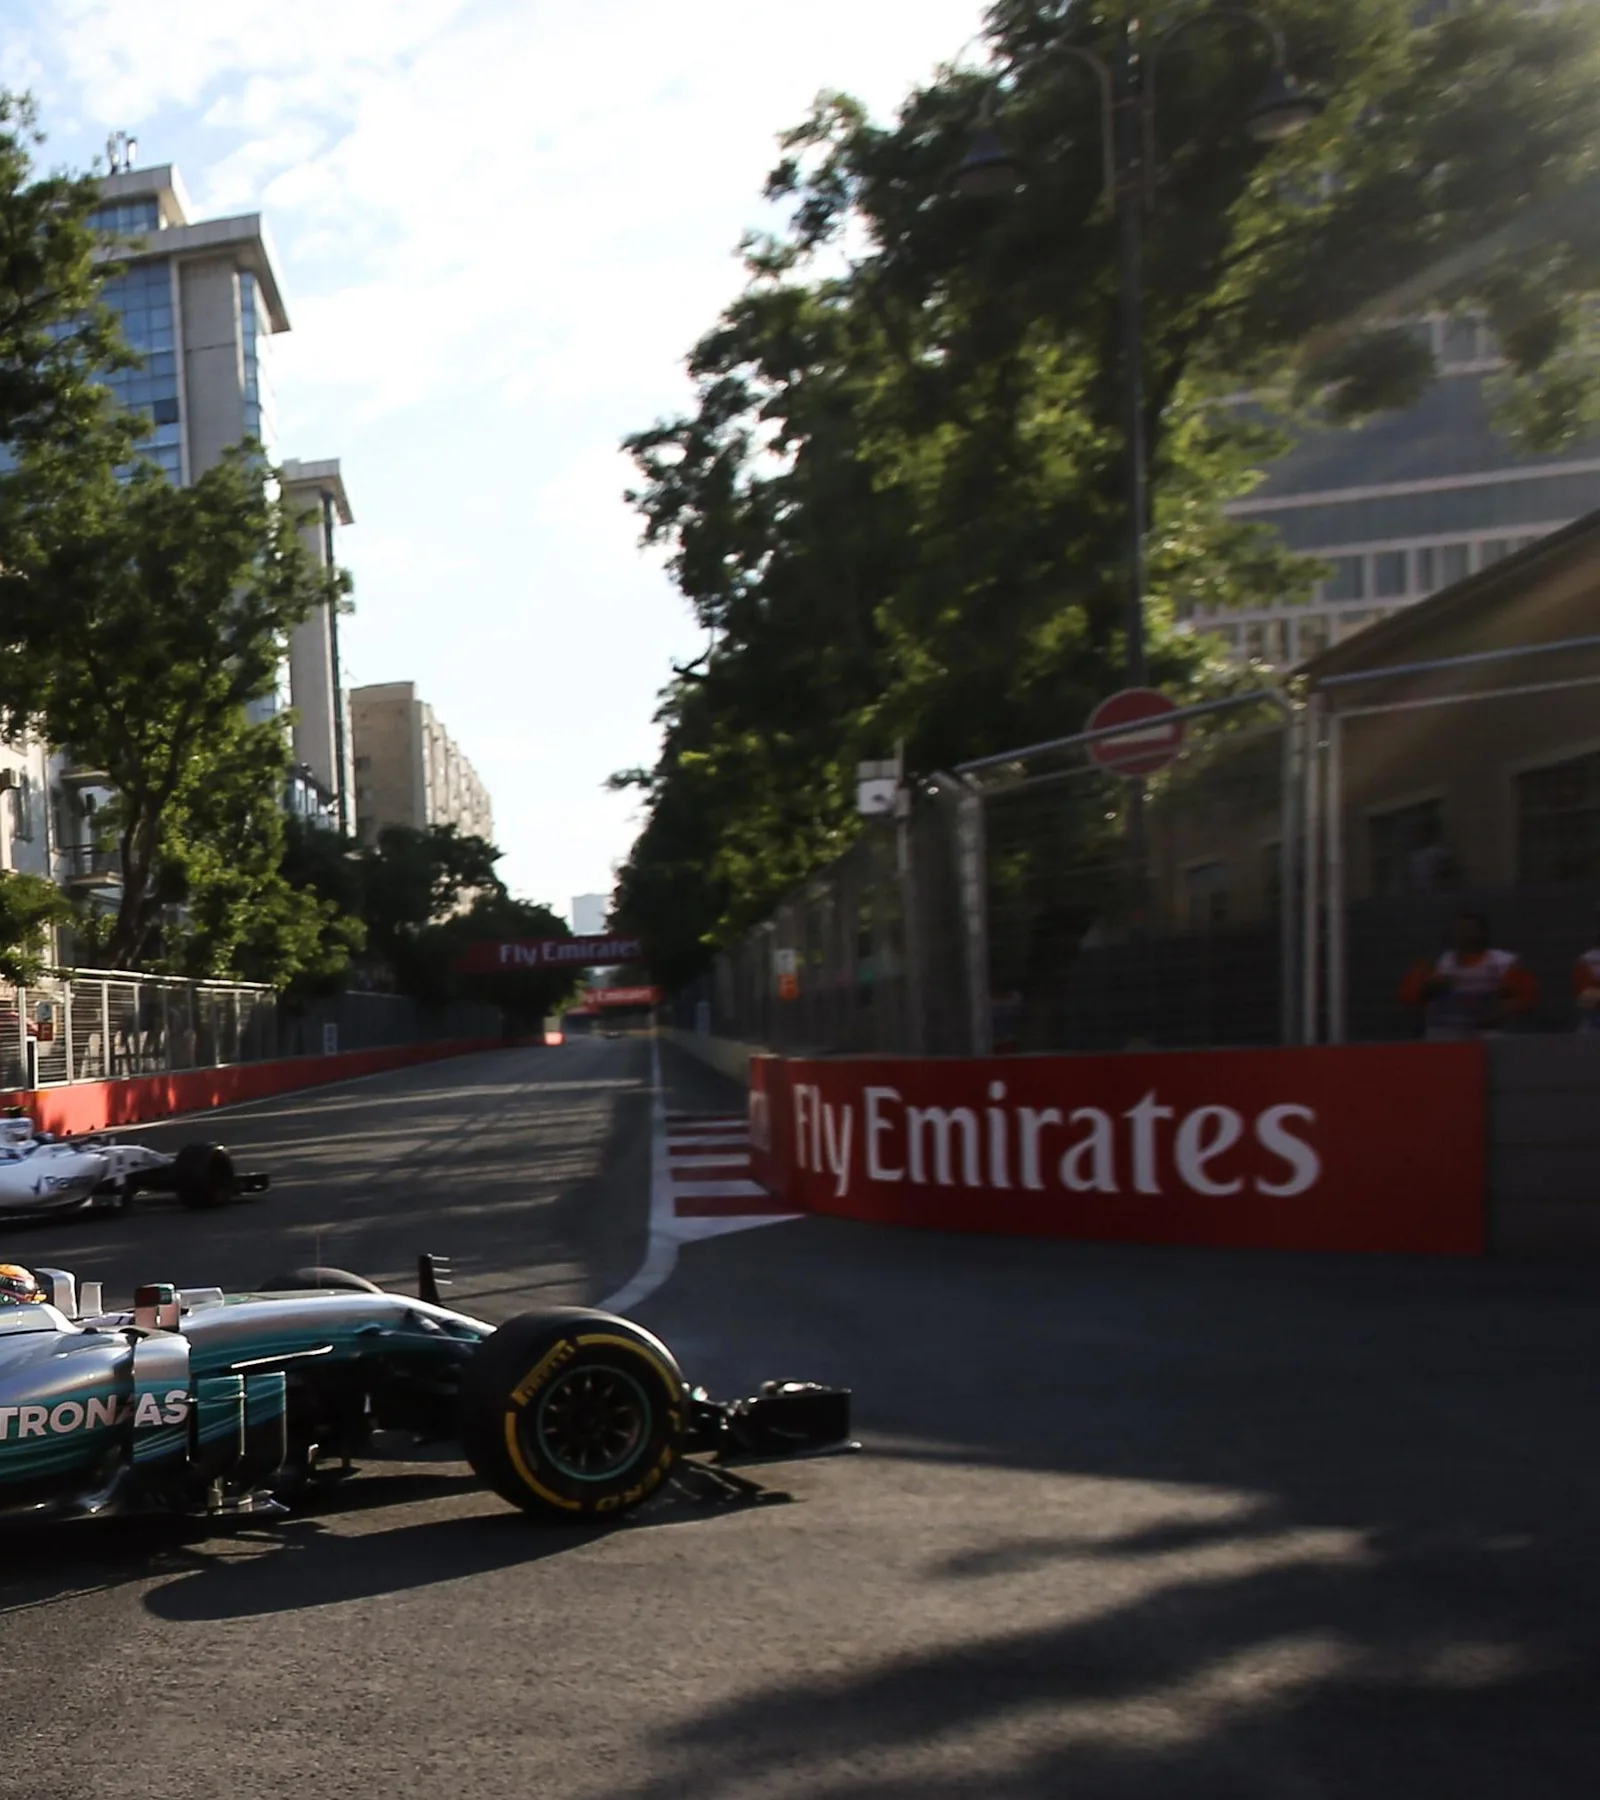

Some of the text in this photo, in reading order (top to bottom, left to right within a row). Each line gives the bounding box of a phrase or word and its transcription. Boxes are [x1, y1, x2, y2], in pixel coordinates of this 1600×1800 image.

[500, 943, 537, 965] Fly
[793, 1083, 853, 1197] Fly
[862, 1080, 1322, 1198] Emirates
